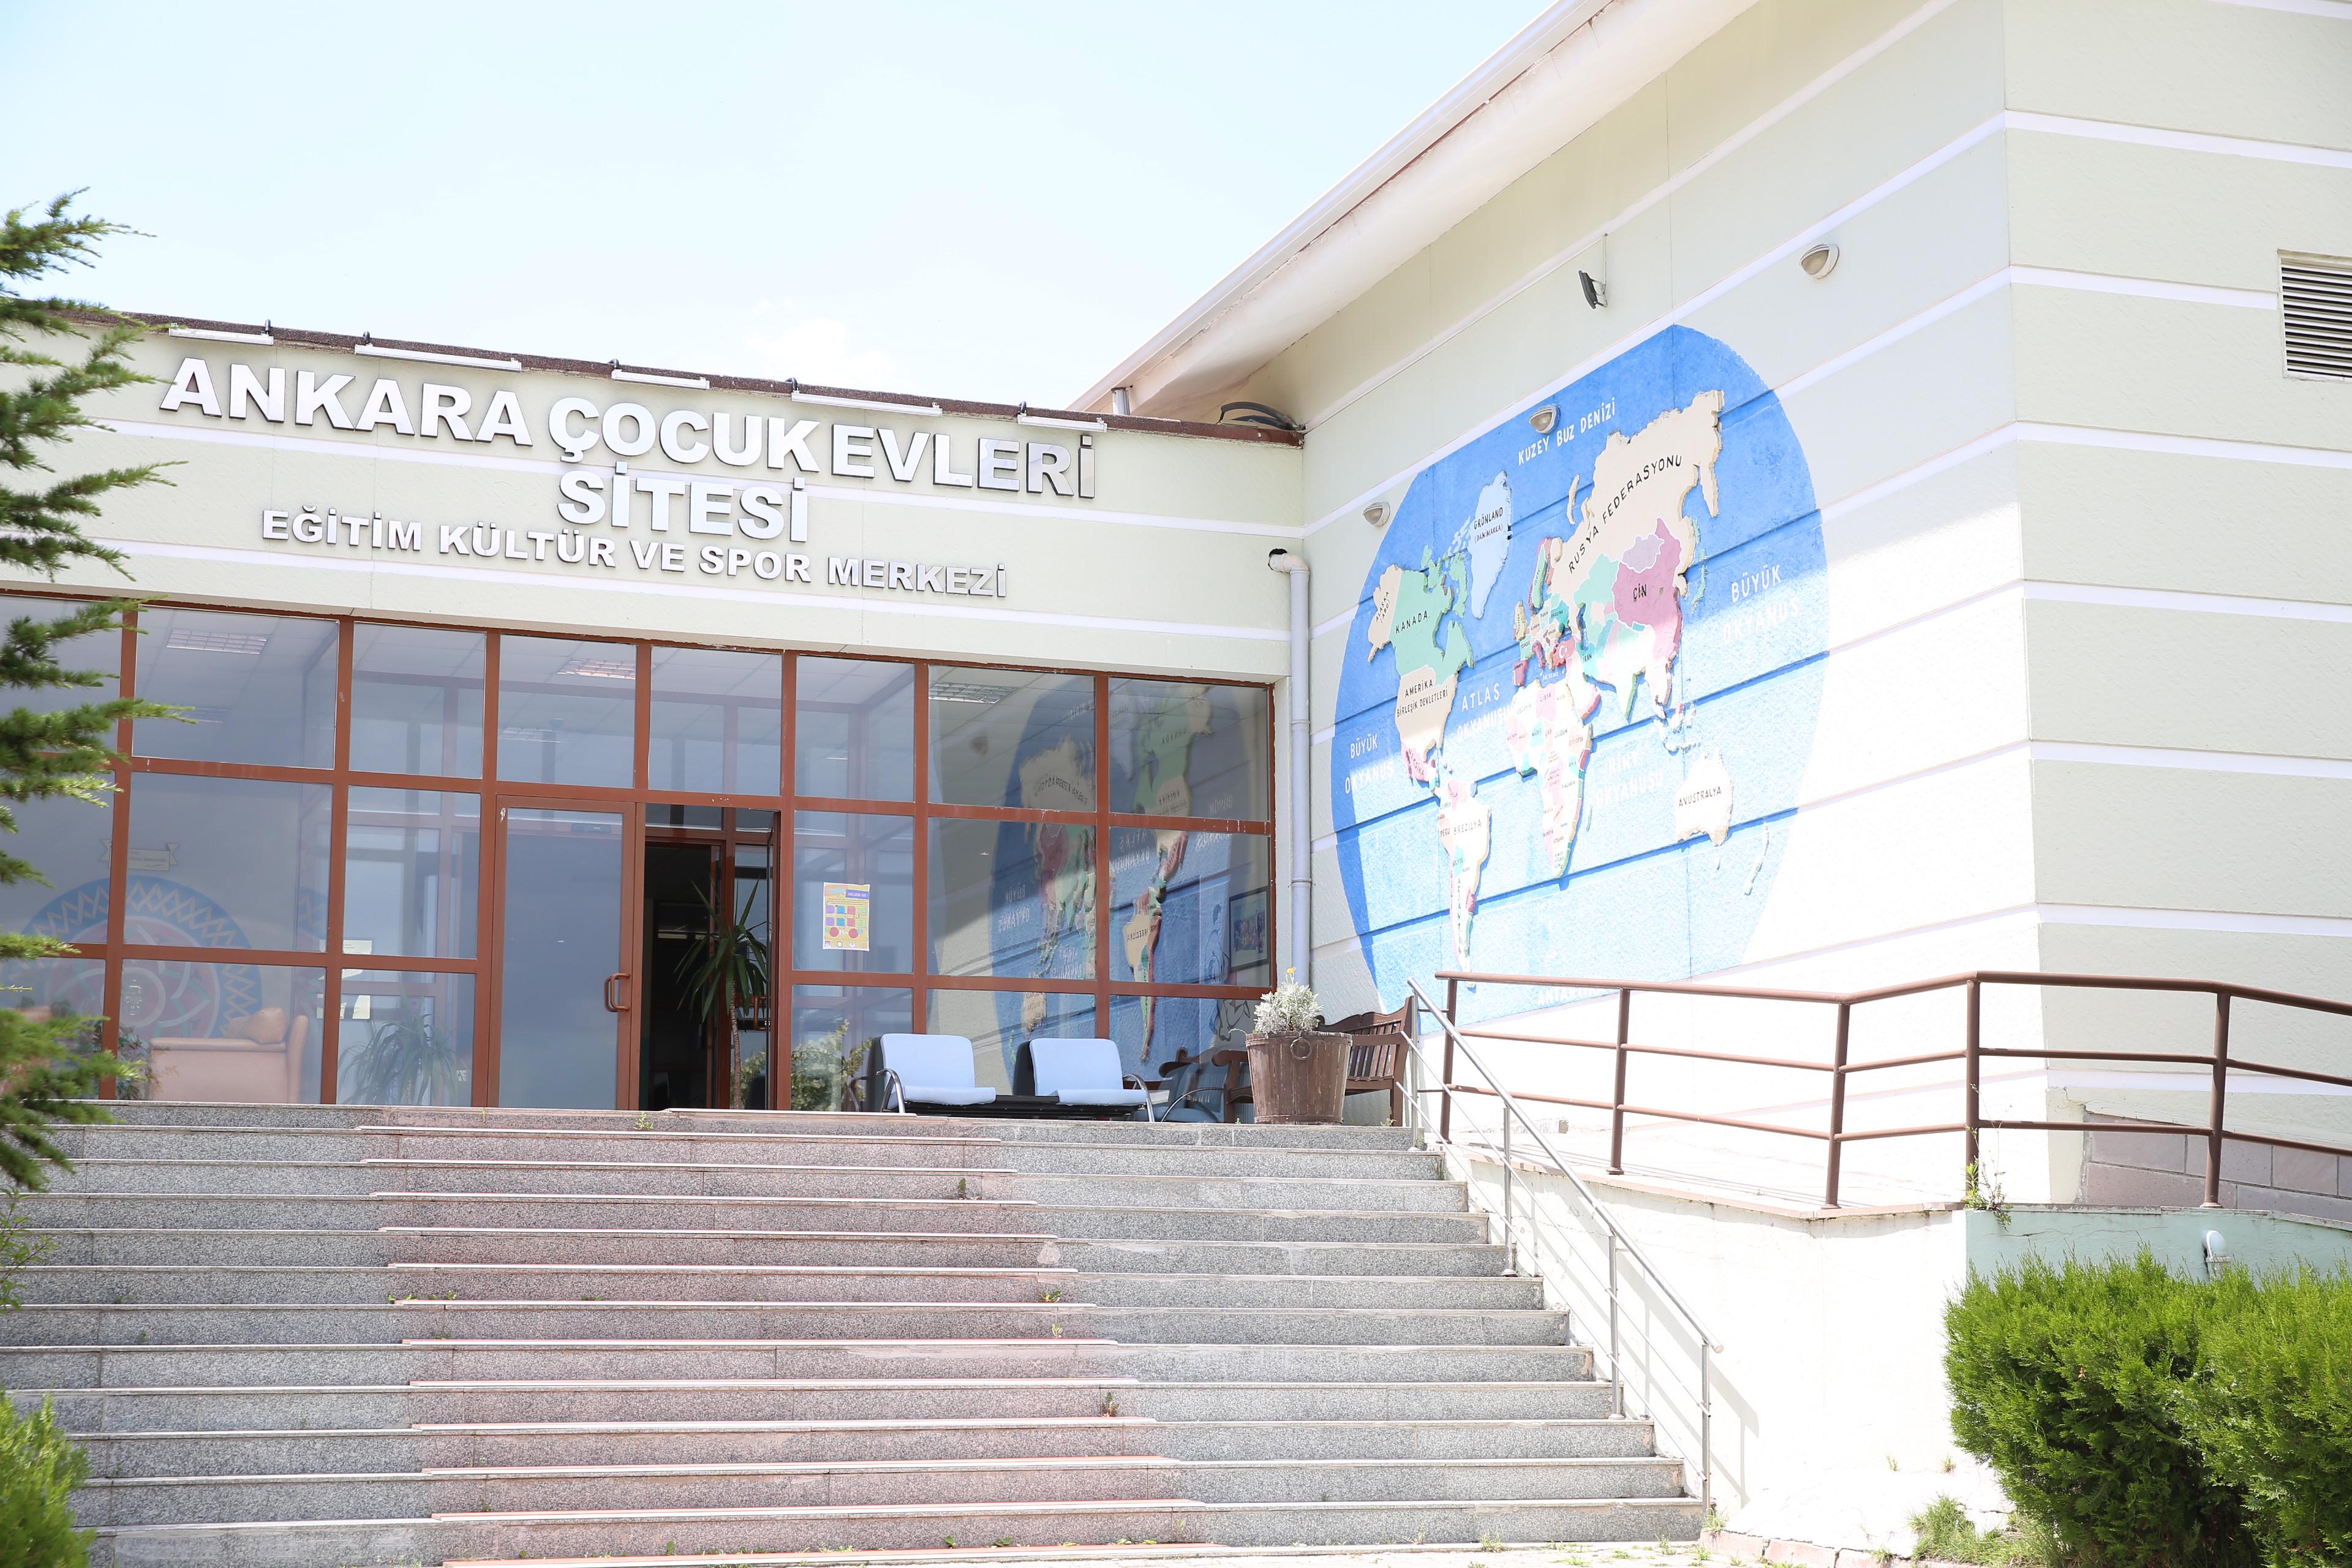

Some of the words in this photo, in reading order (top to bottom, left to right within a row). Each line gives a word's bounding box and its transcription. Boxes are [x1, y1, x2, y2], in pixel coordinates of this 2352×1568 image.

[159, 356, 533, 447] ANKARA
[548, 397, 821, 473] ÇOCUK
[831, 423, 1096, 499] EVLERİ
[1518, 435, 1550, 466] KUZEY
[1556, 424, 1575, 447] BUZ
[1580, 397, 1615, 434] DENİZİ
[557, 461, 808, 543] SİTESİ
[1474, 507, 1503, 529] GRÖNLAND
[1569, 526, 1599, 574] RUSYA
[1602, 454, 1682, 524] FEDERASYONU
[262, 505, 421, 551] EĞİTİM
[439, 521, 615, 568] KÜLTÜR
[630, 539, 685, 573] VE
[699, 545, 812, 582] SPOR
[828, 556, 1006, 598] MERKEZİ
[1633, 582, 1647, 602] ÇİN
[1732, 564, 1781, 603] BÜYÜK
[1396, 610, 1428, 634] KANADA
[1722, 595, 1799, 643] OKYANUS
[1397, 699, 1418, 718] BİRLEŞİK
[1420, 686, 1448, 707] DEVLETLERİ
[1405, 679, 1433, 698] AMERİKA
[1461, 682, 1500, 713] ATLAS
[1351, 733, 1378, 759] BÜYÜK
[1345, 760, 1394, 794] OKYANUS
[1678, 786, 1721, 808] AVUSTRALYA
